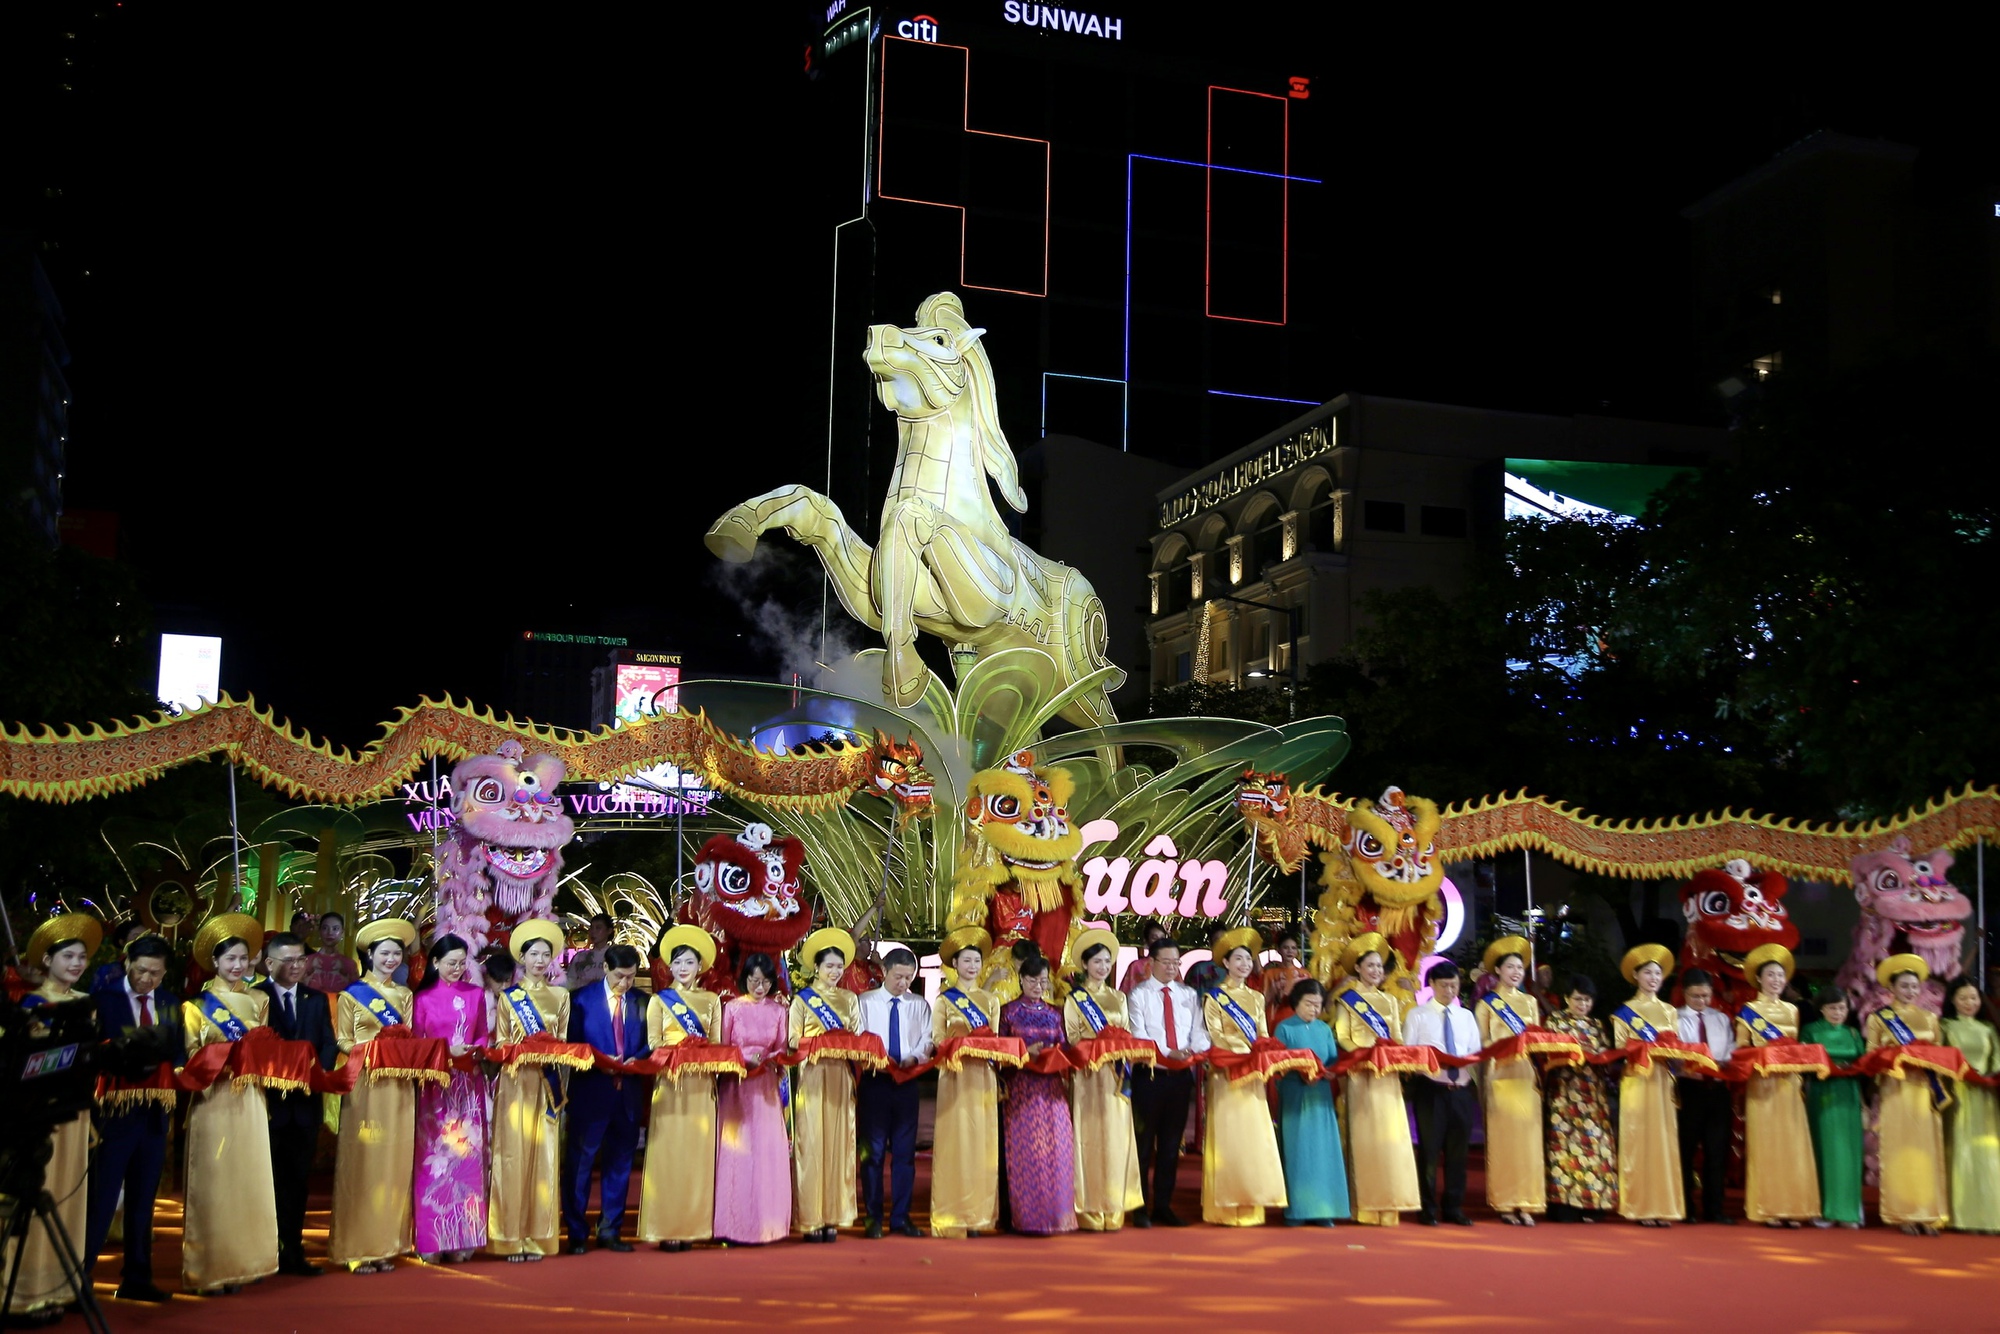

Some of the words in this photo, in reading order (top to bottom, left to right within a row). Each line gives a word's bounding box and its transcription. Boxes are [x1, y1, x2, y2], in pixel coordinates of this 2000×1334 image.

[898, 19, 938, 43] citi
[1003, 0, 1122, 41] SUNWAH
[534, 632, 574, 643] HARBOUR
[575, 635, 597, 645] VIEW
[597, 636, 628, 646] TOWER
[635, 653, 658, 663] SAIGON
[659, 655, 682, 665] PRINCE
[24, 1047, 76, 1077] HTV
